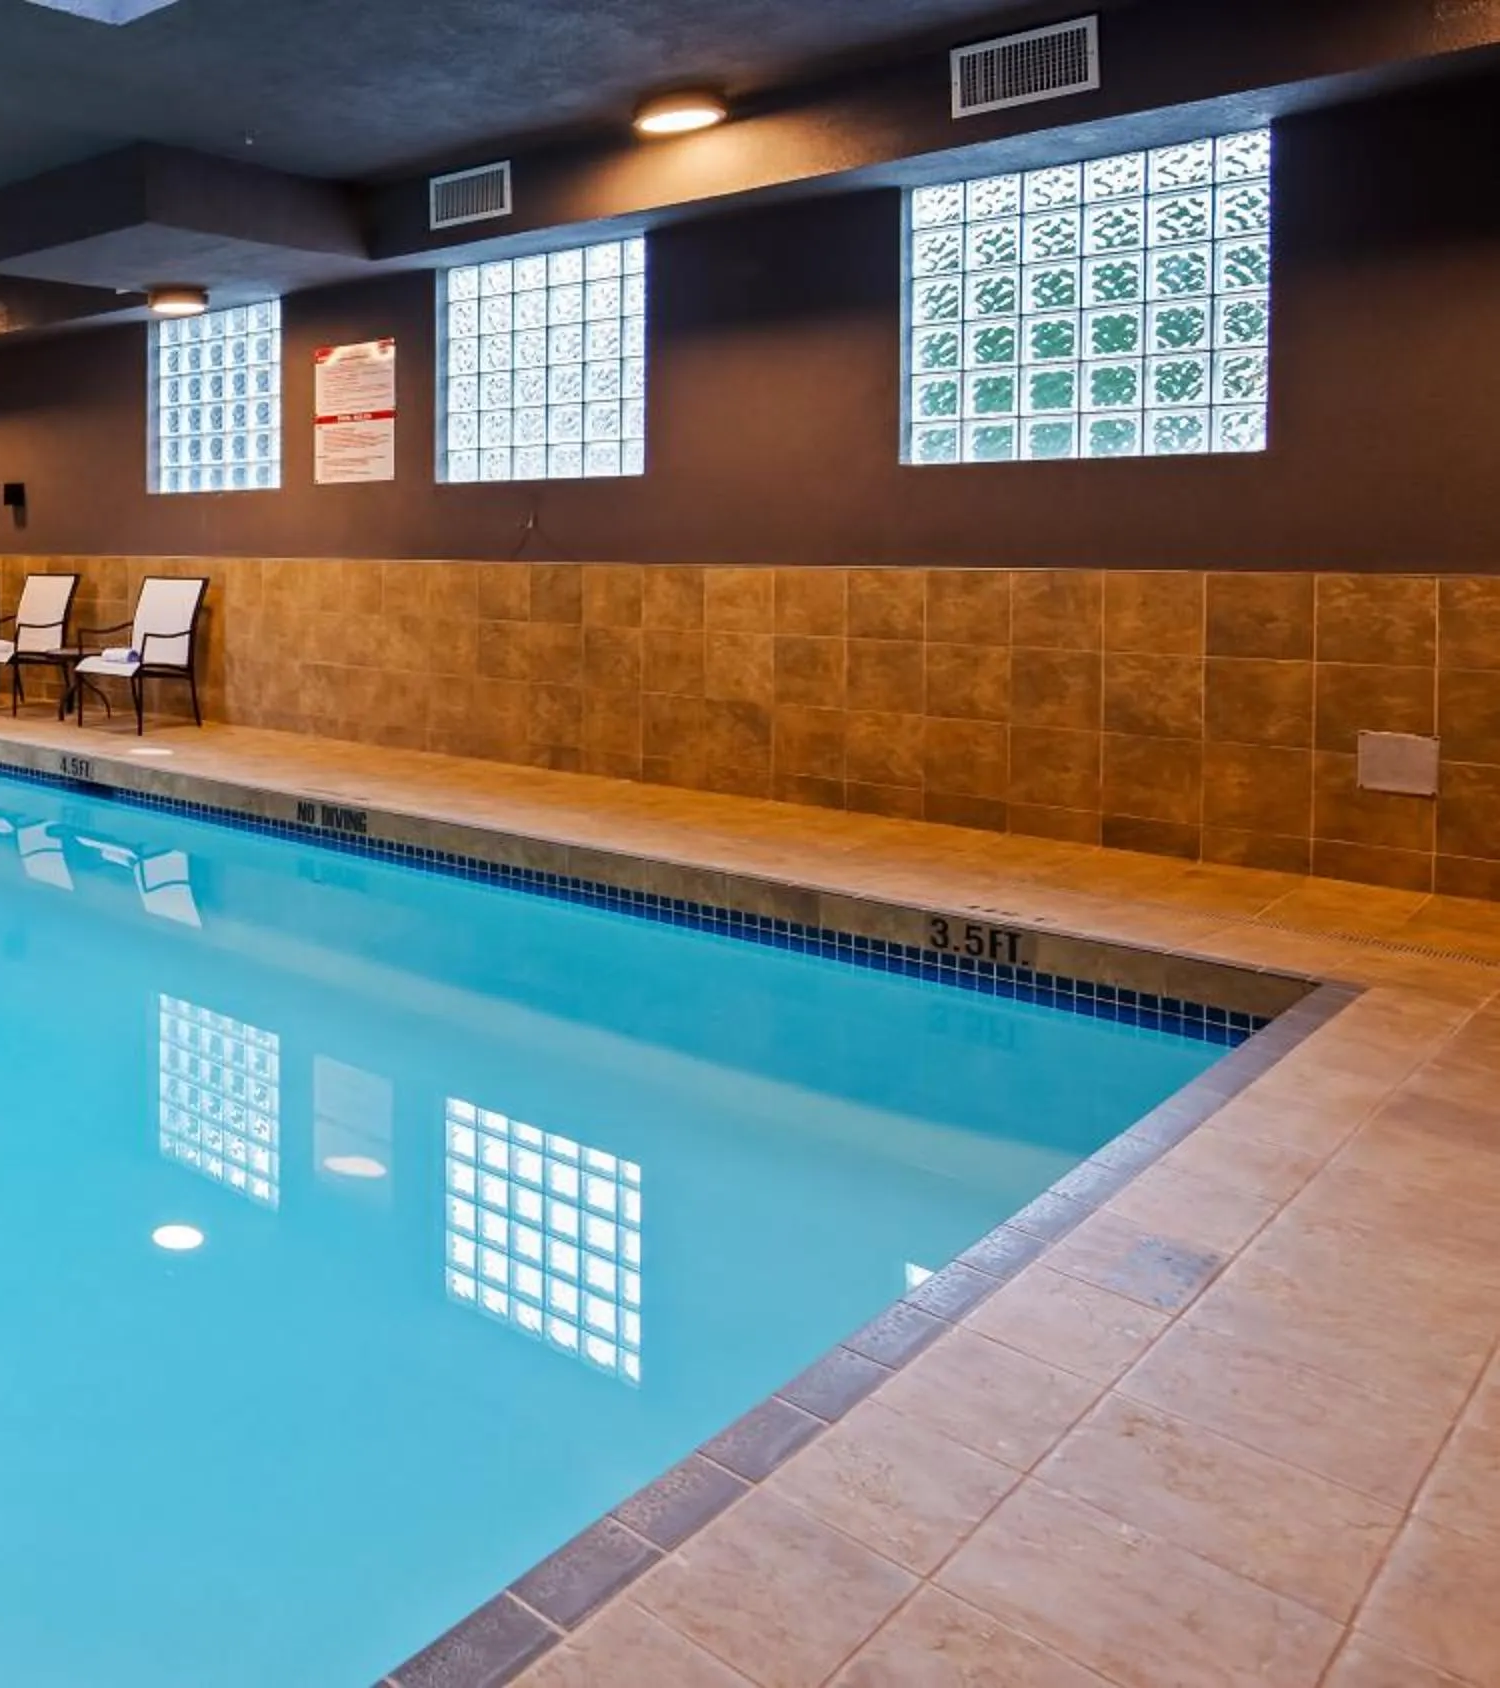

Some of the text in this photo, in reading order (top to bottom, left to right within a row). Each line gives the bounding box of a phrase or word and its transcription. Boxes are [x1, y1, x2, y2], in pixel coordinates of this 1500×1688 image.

[297, 801, 367, 833] NO DIVING
[930, 918, 1029, 965] 3.5FT.
